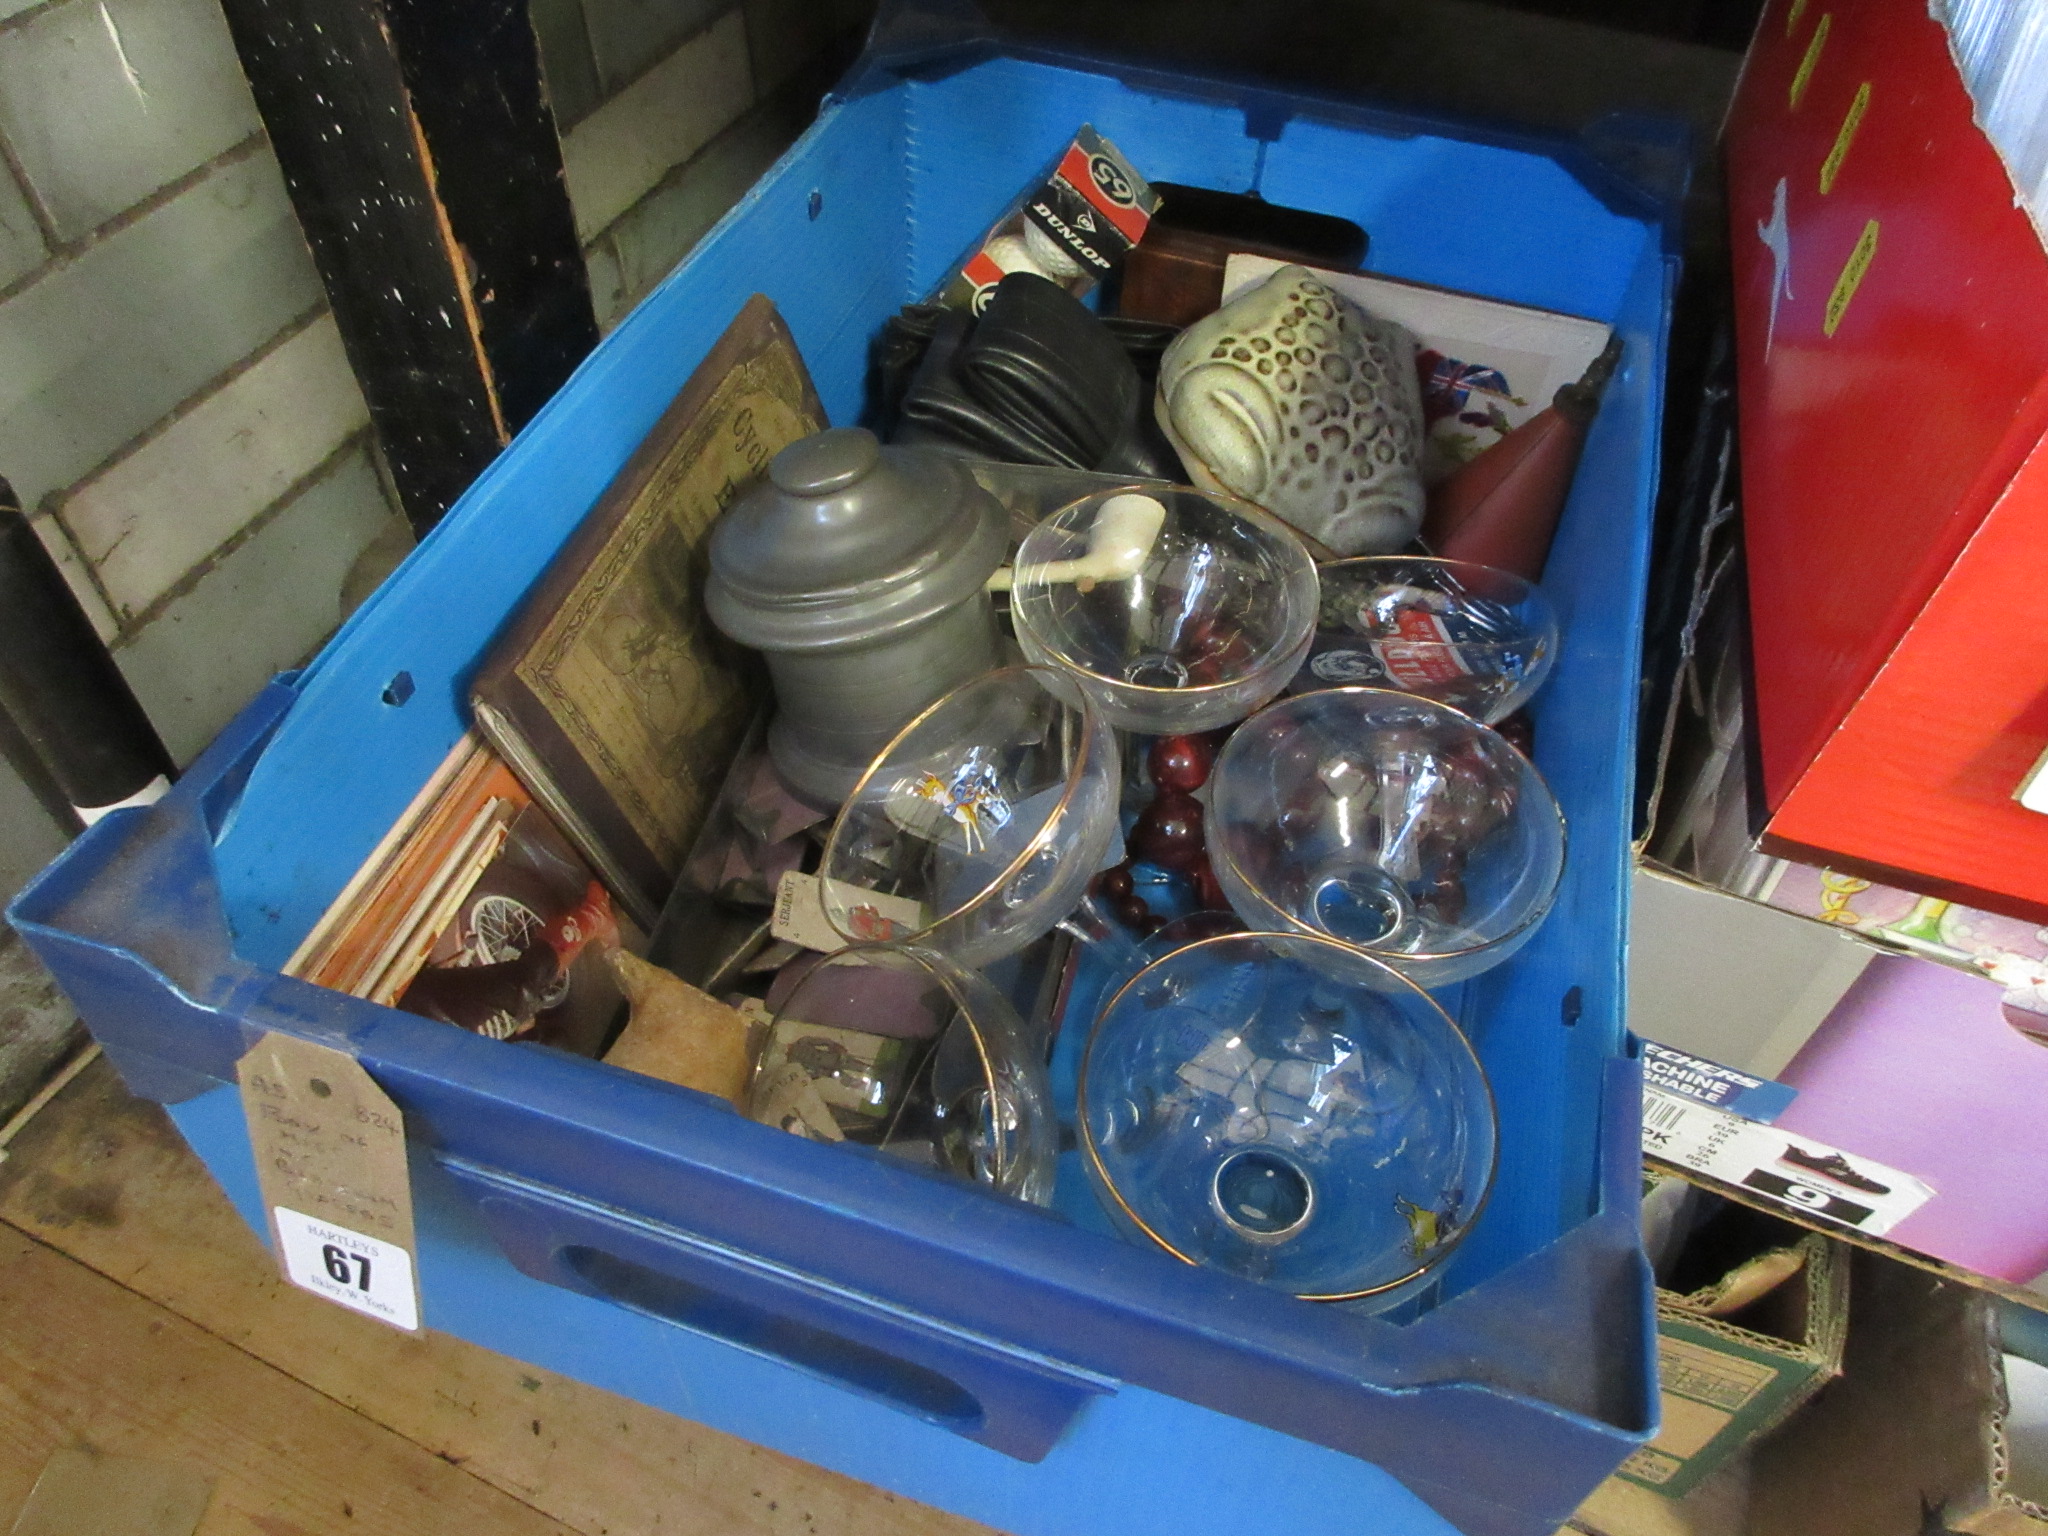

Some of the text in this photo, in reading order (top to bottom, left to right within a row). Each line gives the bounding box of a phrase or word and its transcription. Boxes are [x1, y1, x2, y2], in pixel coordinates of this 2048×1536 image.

[1032, 202, 1112, 271] DUNLOP
[1643, 1057, 1731, 1095] ACHINE
[1644, 1043, 1764, 1089] ECHERS
[1643, 1069, 1722, 1103] SHABLE
[1708, 1135, 1727, 1145] UK
[1713, 1124, 1740, 1136] EUR
[1698, 1145, 1718, 1155] CM
[1782, 1184, 1831, 1209] 9
[307, 1224, 379, 1257] HARTLEYS
[322, 1244, 371, 1292] 67
